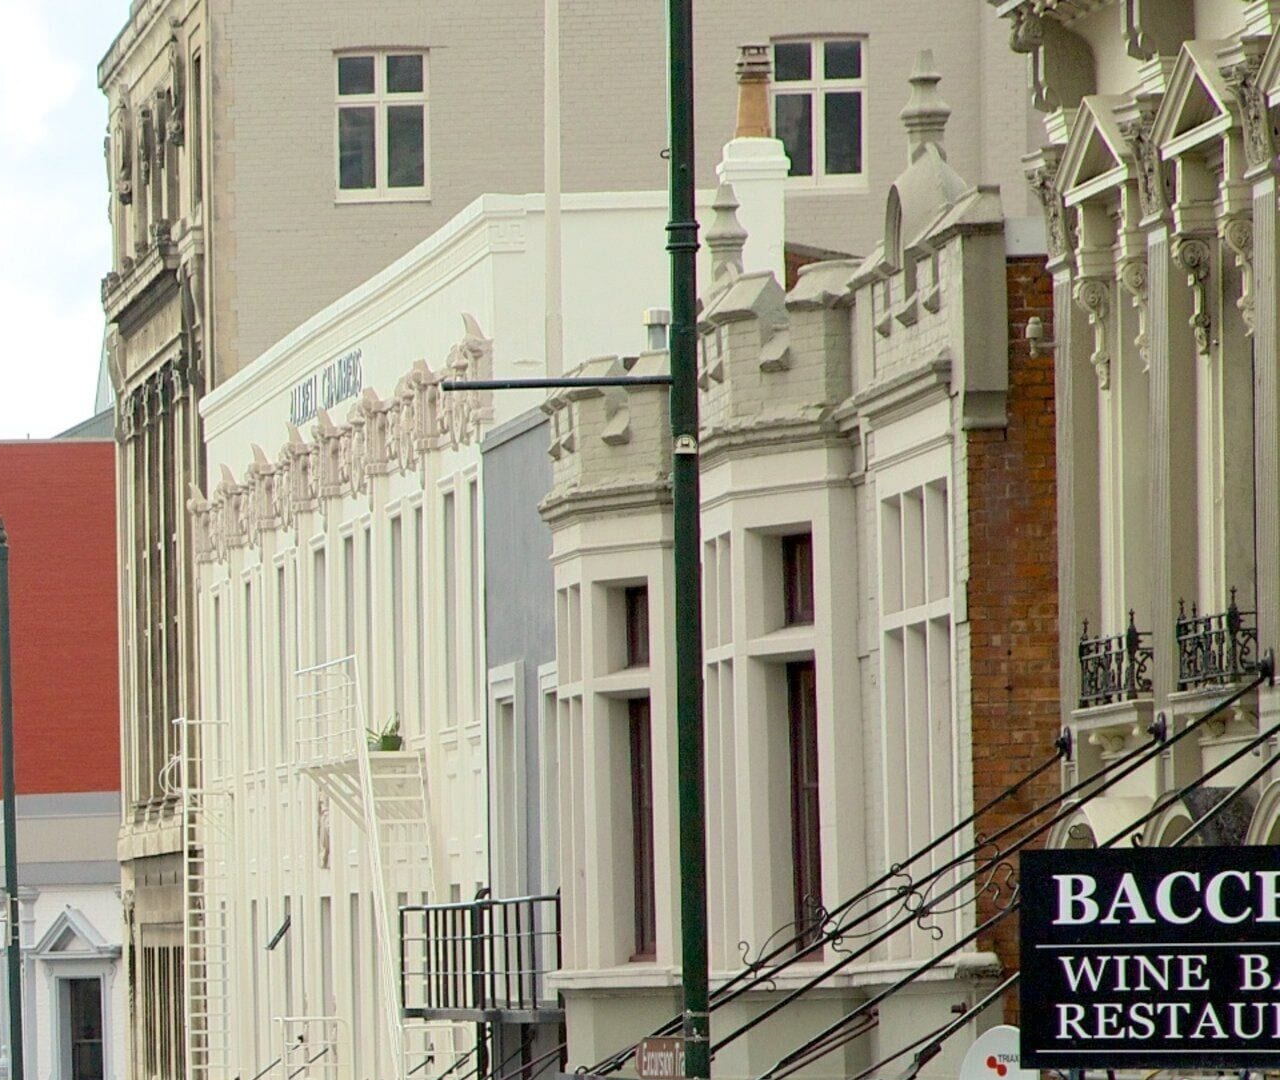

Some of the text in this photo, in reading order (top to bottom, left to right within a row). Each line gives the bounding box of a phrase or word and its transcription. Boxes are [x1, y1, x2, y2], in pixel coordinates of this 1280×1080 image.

[1058, 954, 1280, 992] WINE B
[1055, 1002, 1280, 1039] RESTAU
